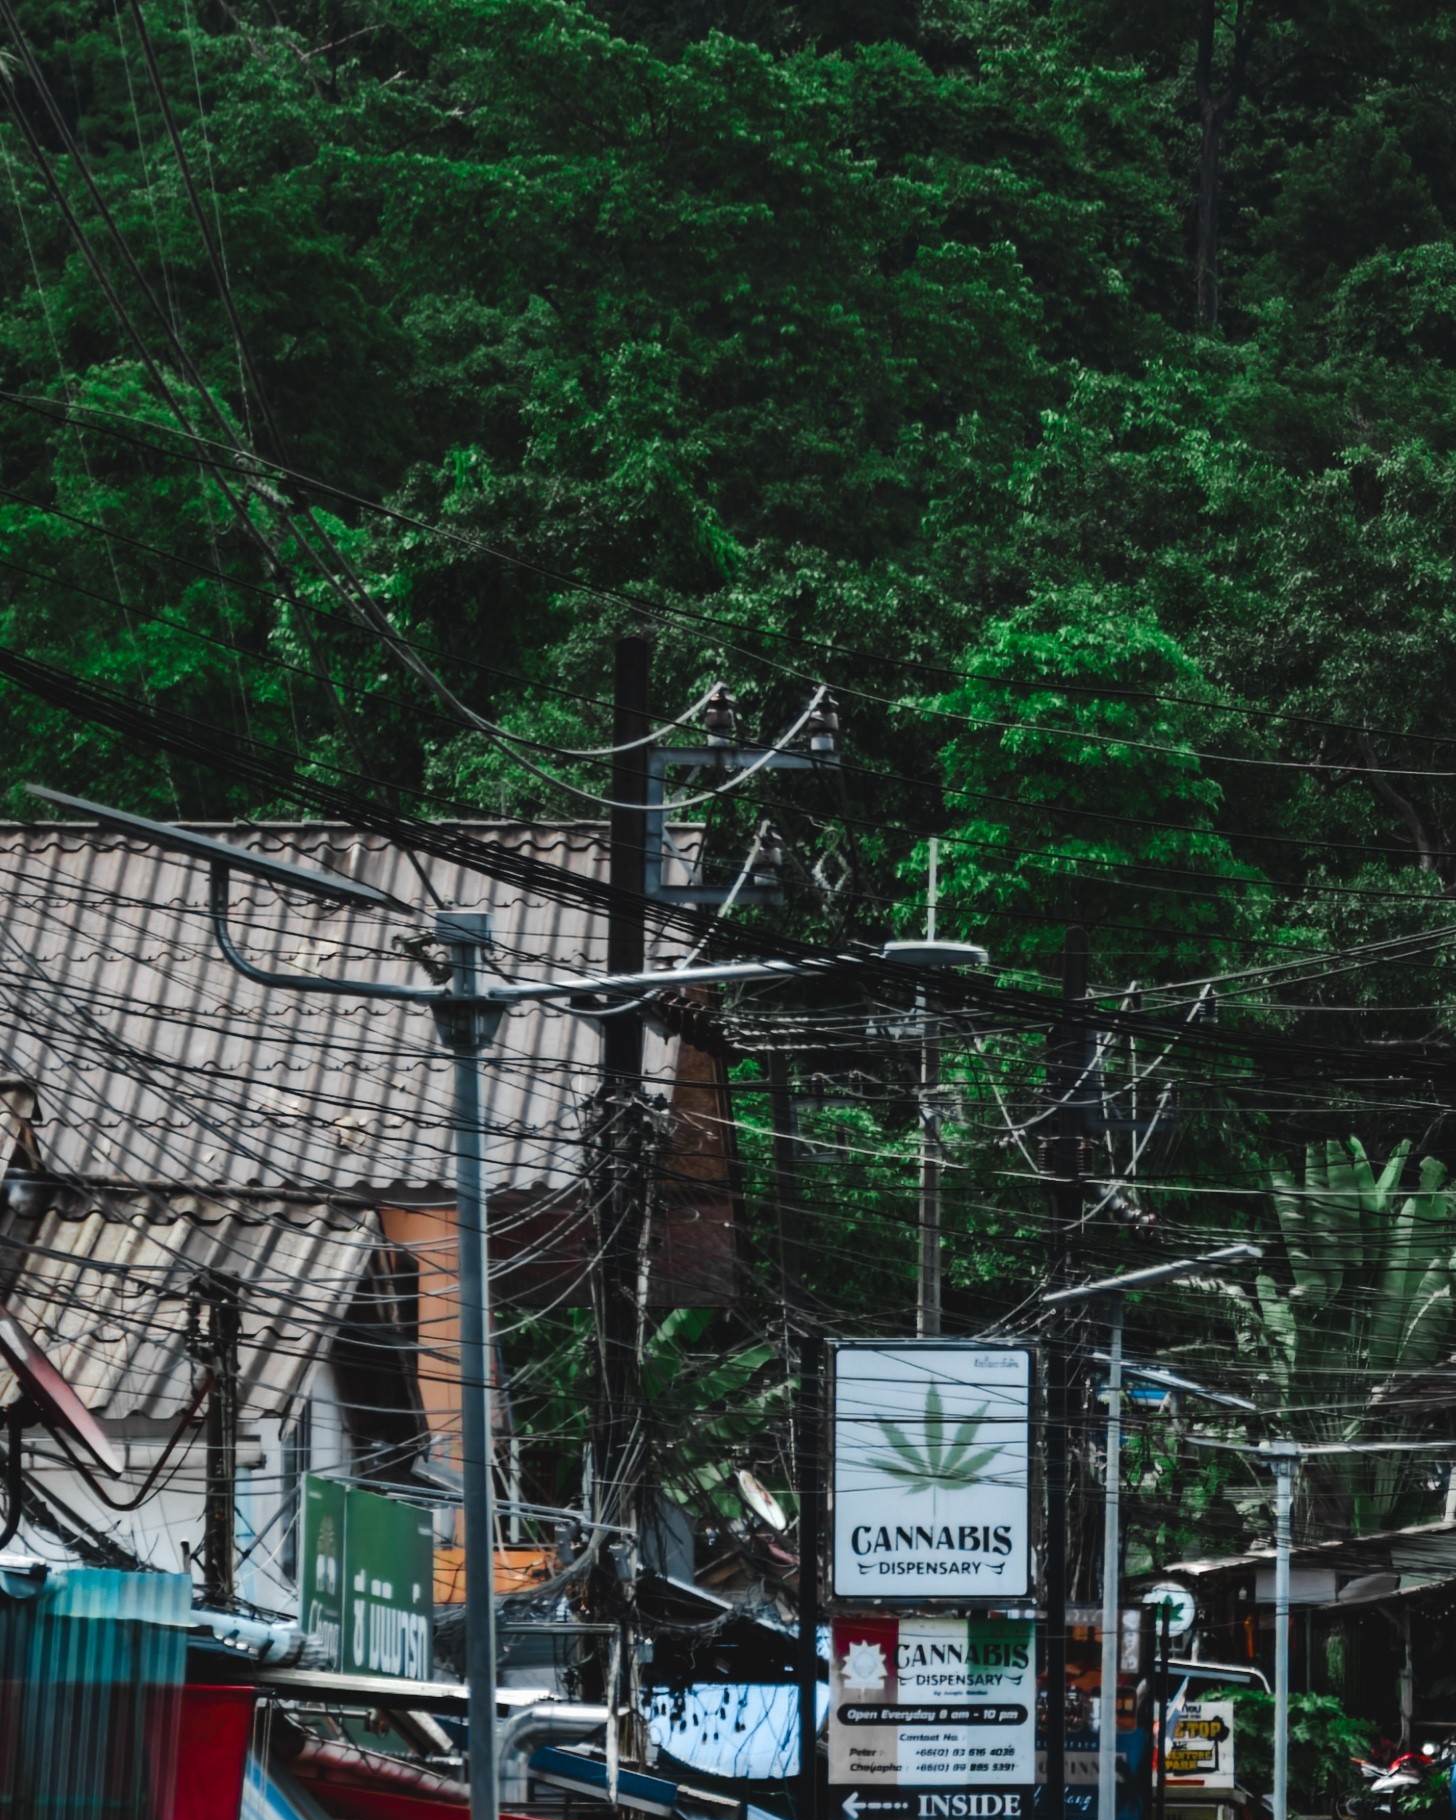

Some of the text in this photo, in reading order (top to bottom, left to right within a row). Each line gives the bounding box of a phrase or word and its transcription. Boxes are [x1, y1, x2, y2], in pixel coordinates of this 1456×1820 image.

[851, 1525, 1013, 1556] CANNABIS
[878, 1561, 982, 1575] DISPENSARY
[893, 1642, 1030, 1670] CANNABIS
[916, 1673, 1004, 1686] DISPENSARY
[847, 1709, 878, 1720] Open
[881, 1709, 936, 1721] Everyday
[950, 1710, 970, 1719] am
[983, 1709, 996, 1719] 10
[999, 1711, 1019, 1722] pm
[899, 1733, 940, 1742] Contact
[850, 1747, 877, 1757] Peter
[917, 1794, 1022, 1817] INSIDE
